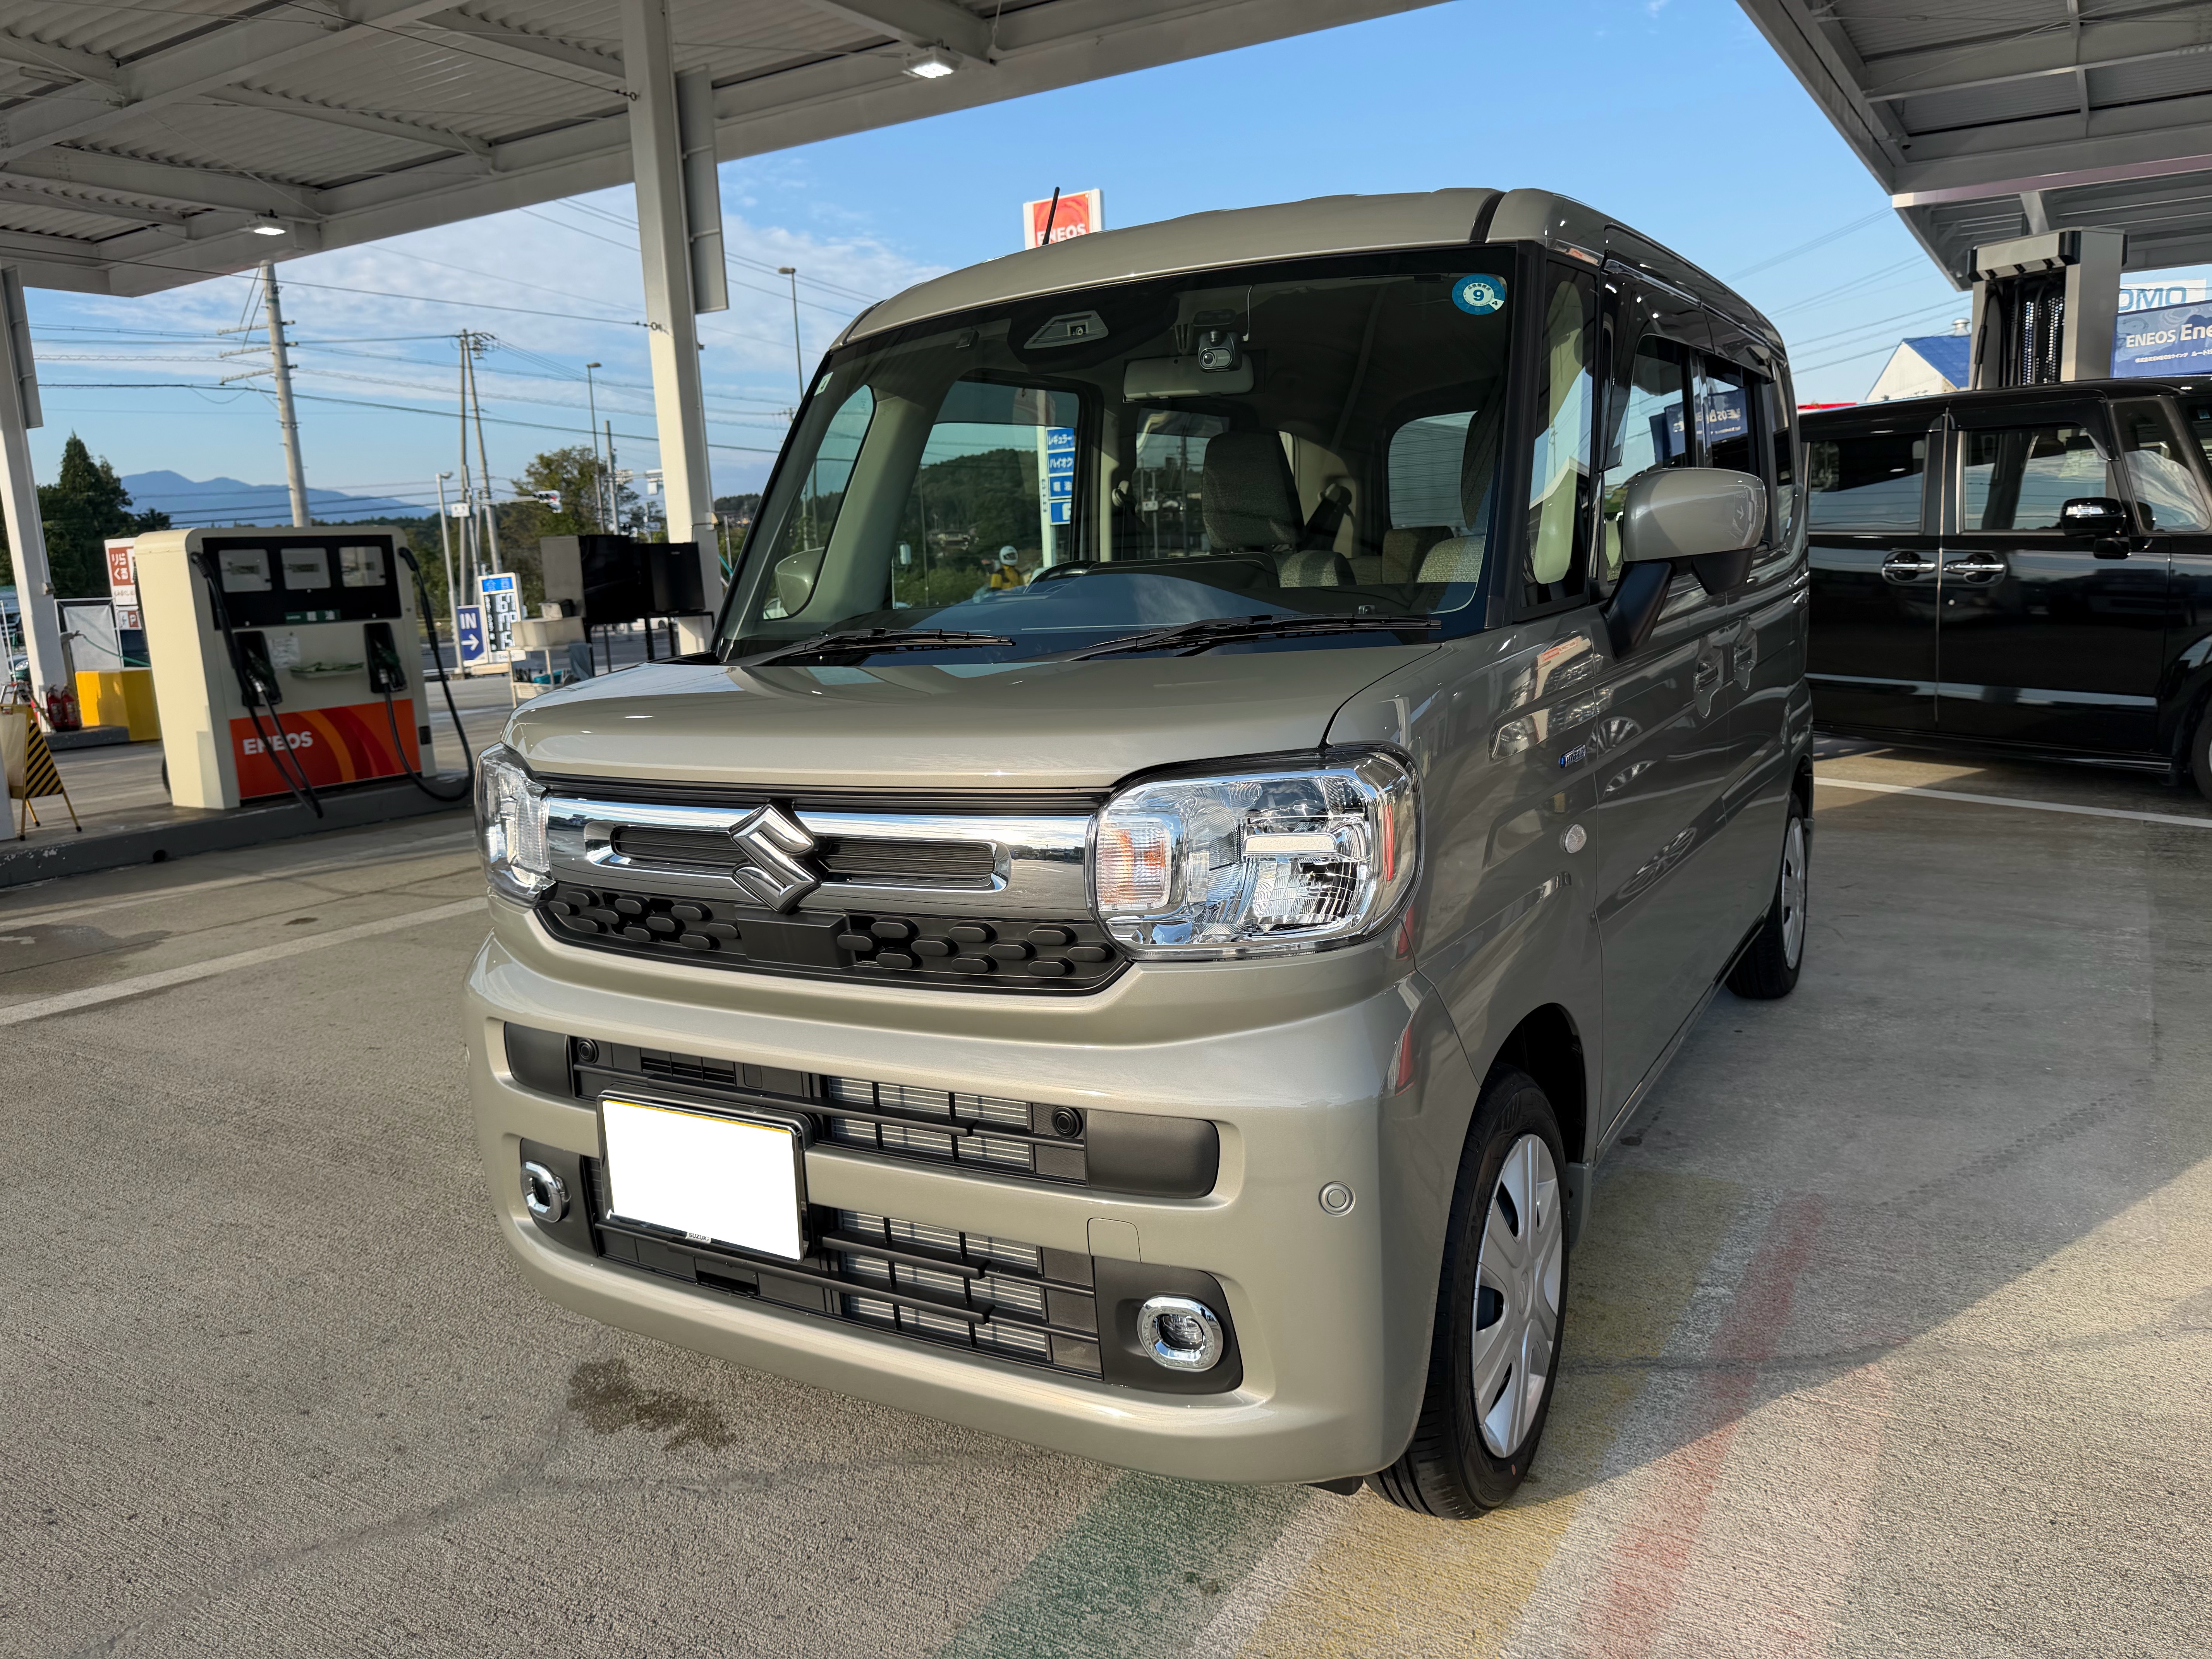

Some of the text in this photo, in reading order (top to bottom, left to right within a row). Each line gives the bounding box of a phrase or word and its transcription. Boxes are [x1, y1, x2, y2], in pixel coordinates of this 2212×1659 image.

[1473, 289, 1484, 301] 9
[2126, 330, 2176, 348] ENEOS
[460, 613, 477, 630] IN
[243, 731, 314, 755] ENEOS
